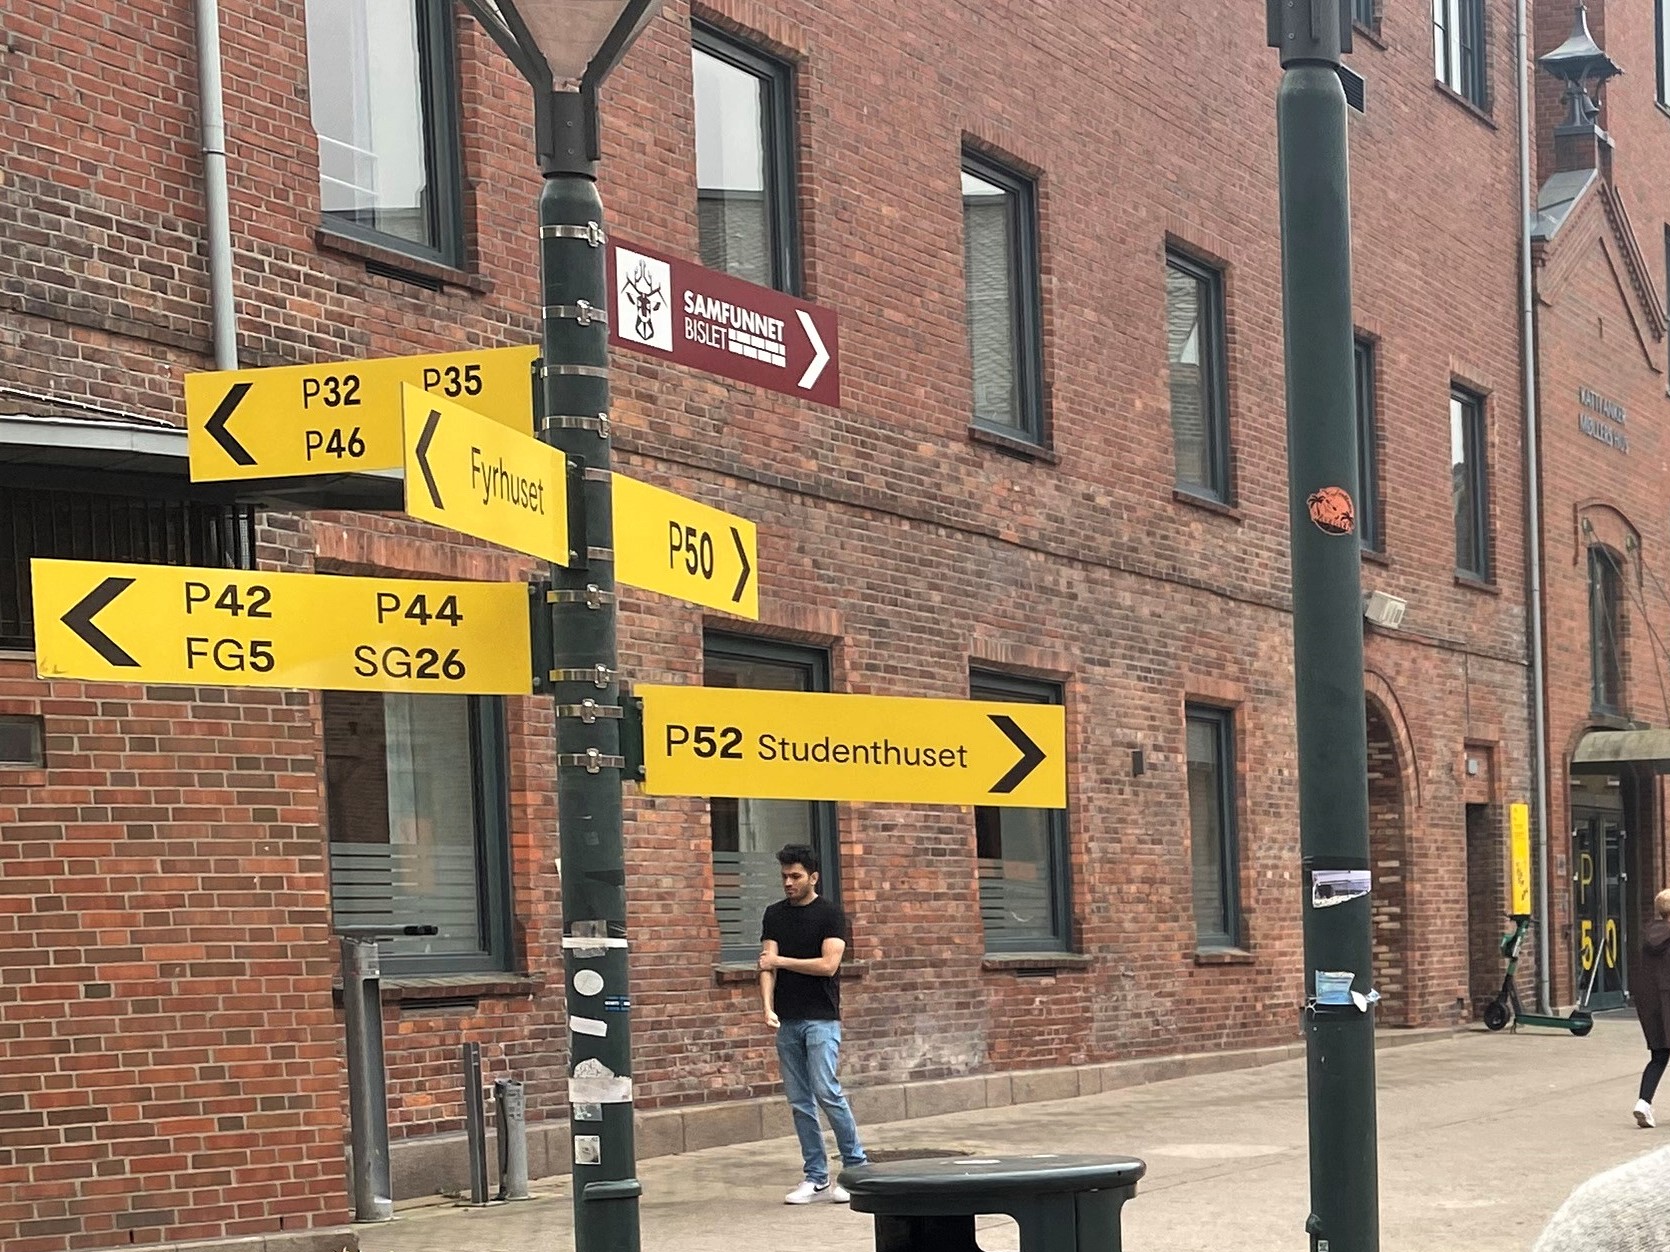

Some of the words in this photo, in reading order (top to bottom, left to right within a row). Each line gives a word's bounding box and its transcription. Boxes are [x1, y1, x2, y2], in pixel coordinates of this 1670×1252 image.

[683, 289, 785, 342] SAMFUNNET
[684, 316, 727, 350] BISLET
[302, 374, 361, 410] P32
[423, 364, 483, 398] P35
[305, 426, 366, 462] P46
[471, 446, 545, 515] Fyrhuset
[669, 520, 714, 580] P50
[185, 581, 272, 619] P42
[376, 592, 464, 627] P44
[186, 636, 275, 673] FG5
[354, 645, 466, 680] SG26
[666, 724, 743, 760] P52
[758, 734, 968, 769] Studenthuset
[1580, 853, 1593, 905] P
